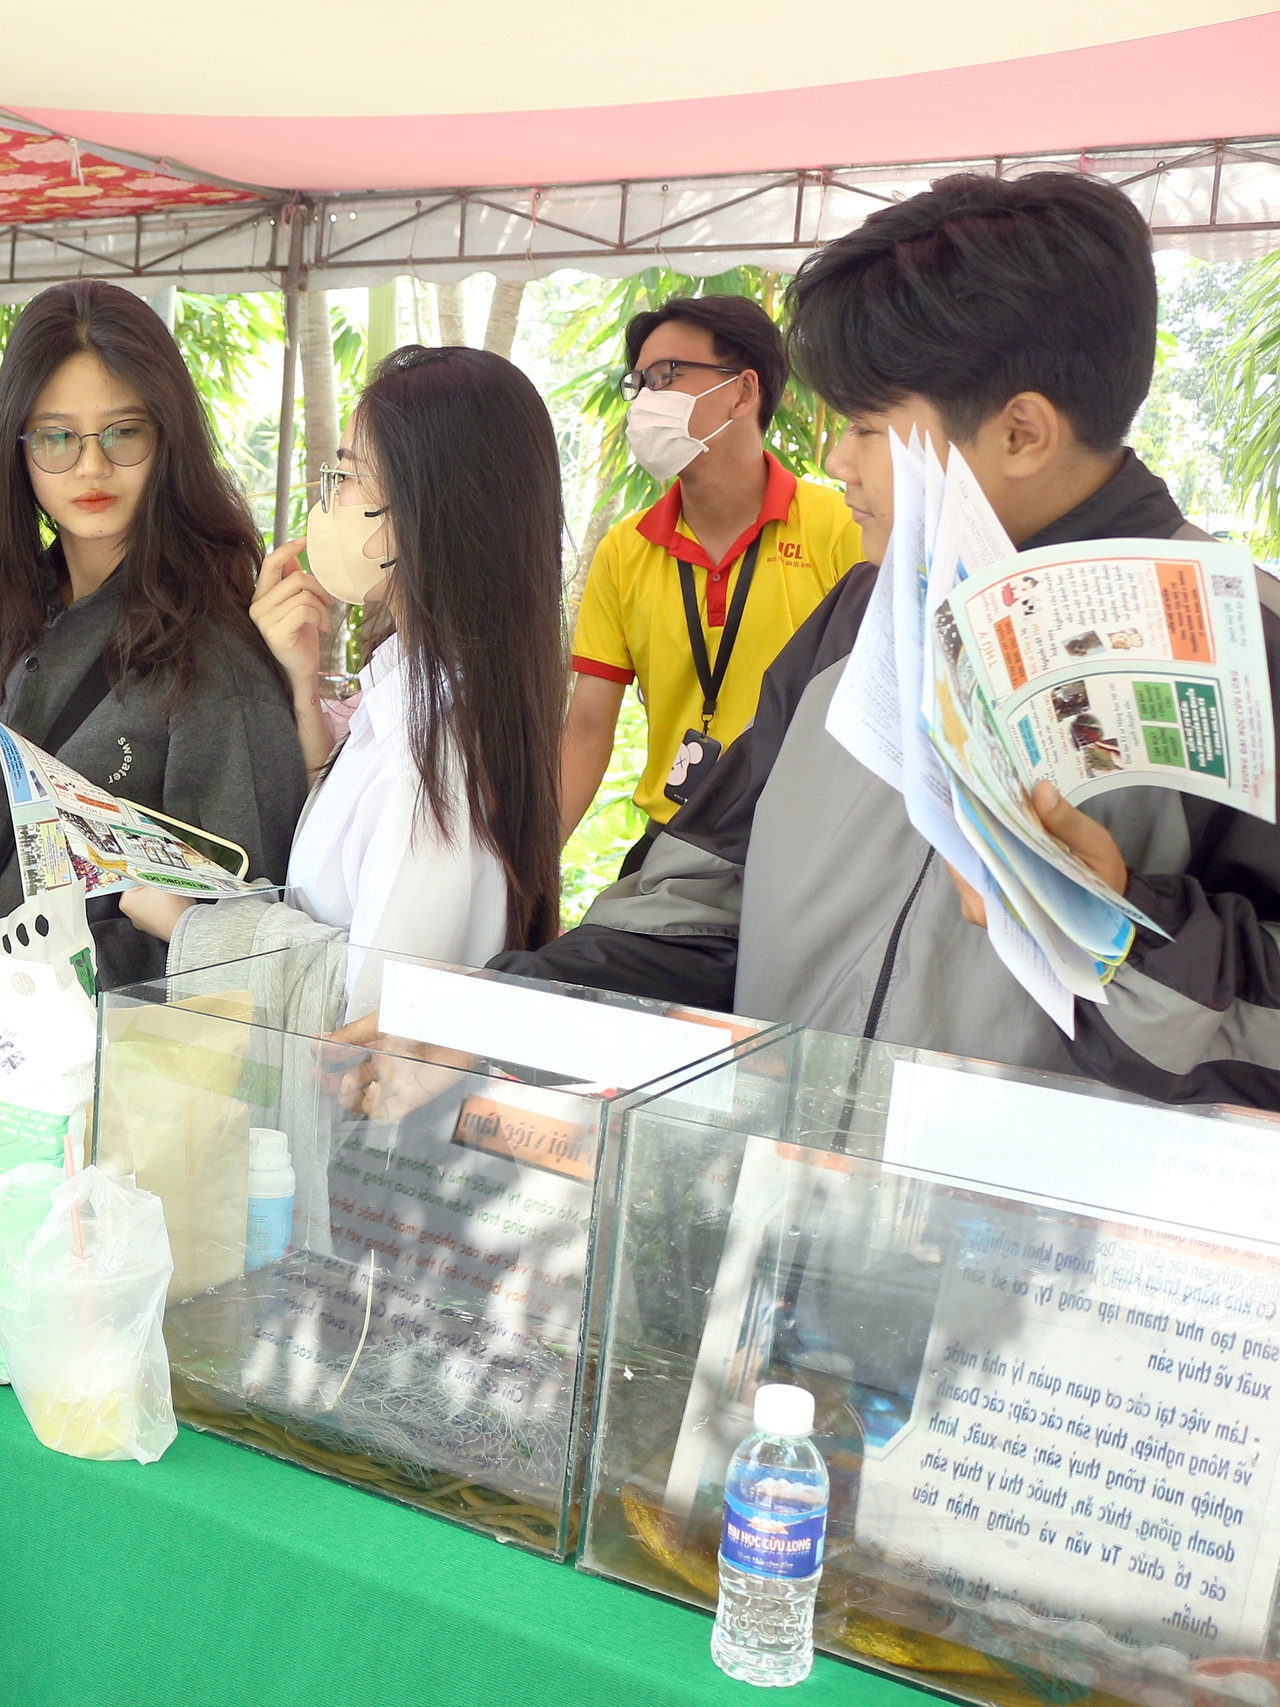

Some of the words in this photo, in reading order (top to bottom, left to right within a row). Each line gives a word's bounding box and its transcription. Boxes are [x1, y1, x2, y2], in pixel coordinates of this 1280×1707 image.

[108, 737, 132, 784] sweater
[741, 1532, 761, 1548] HỌC
[763, 1536, 785, 1552] CỬU
[787, 1538, 812, 1552] LONG
